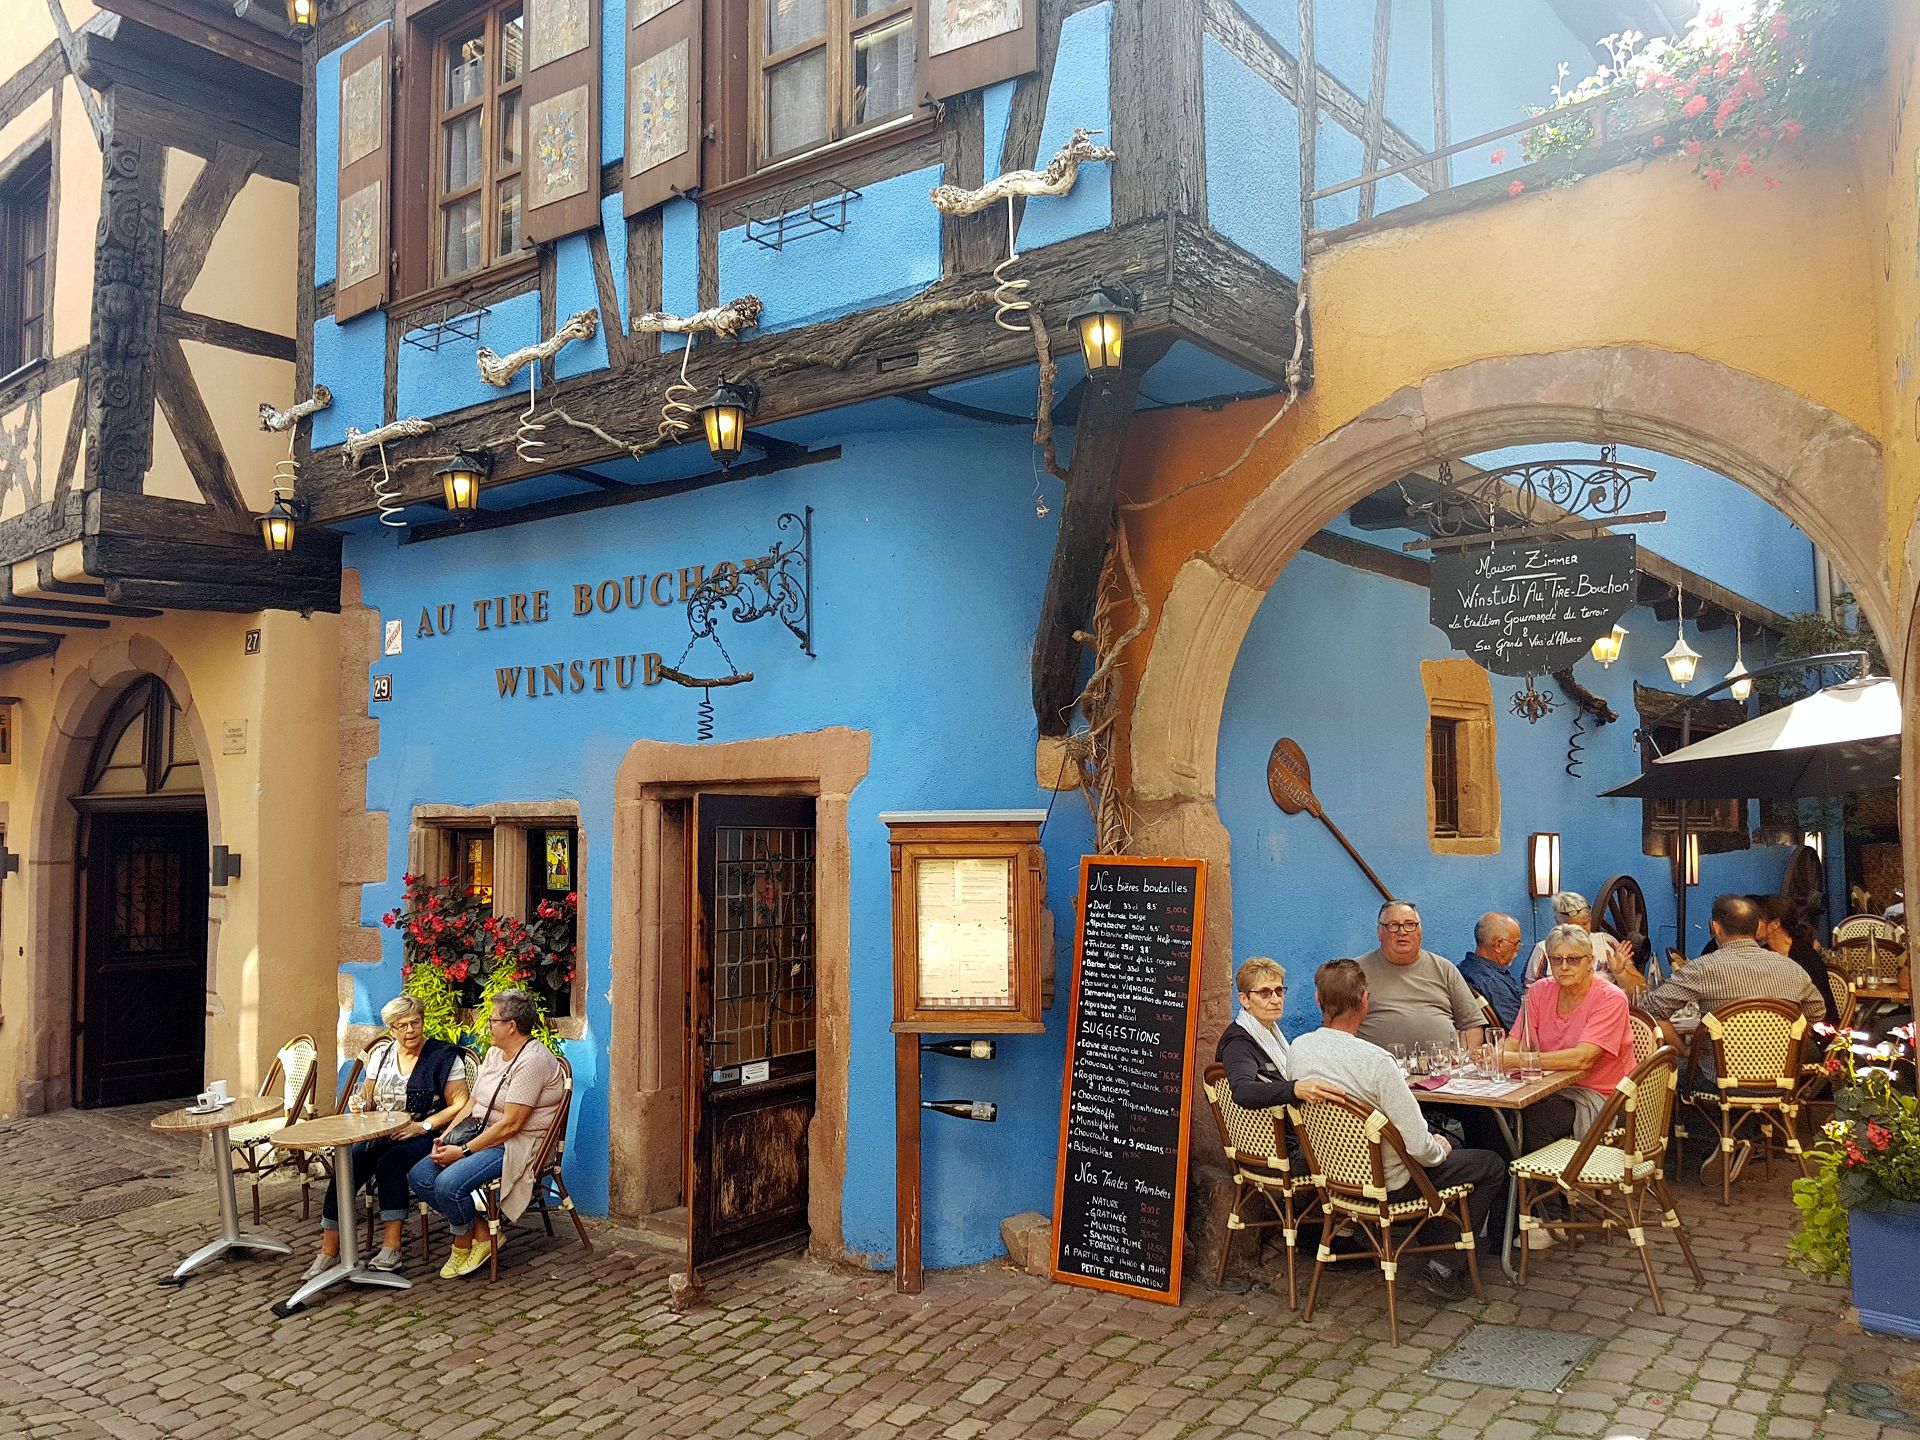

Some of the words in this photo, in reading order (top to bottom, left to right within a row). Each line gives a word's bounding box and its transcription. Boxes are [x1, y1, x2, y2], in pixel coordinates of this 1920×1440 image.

[1475, 556, 1517, 579] Maison
[416, 603, 455, 638] AU
[472, 589, 549, 631] TIRE
[572, 556, 771, 616] BOUCHON
[1448, 614, 1462, 629] La
[1463, 612, 1500, 628] tradition
[1503, 608, 1557, 635] Gourmande
[1564, 606, 1577, 619] du
[1580, 605, 1609, 619] terroir
[246, 633, 259, 651] 27
[1473, 639, 1491, 652] Ses
[1495, 638, 1523, 657] Grands
[1528, 633, 1544, 648] Vins
[1546, 630, 1582, 647] d'Alsace
[495, 652, 663, 699] WINSTUB
[374, 679, 389, 698] 29
[1090, 870, 1113, 892] Nos
[1116, 876, 1140, 892] bières
[1142, 878, 1188, 893] bouteilles
[1092, 900, 1112, 910] Duvel
[1107, 912, 1127, 920] blonde
[1128, 912, 1147, 922] belge
[1155, 958, 1177, 968] rouges
[1111, 982, 1119, 990] du
[1117, 1012, 1137, 1021] alcool
[1100, 1042, 1109, 1051] de
[1130, 1047, 1139, 1055] de
[1079, 1057, 1115, 1071] Choucroute
[1131, 1057, 1145, 1065] miel
[1078, 1069, 1104, 1084] Rognon
[1077, 1089, 1116, 1105] Choucroute
[1098, 1082, 1132, 1096] l'ancienne
[1074, 1127, 1110, 1141] Choucroute
[1128, 1138, 1135, 1148] 3
[1135, 1141, 1164, 1155] poissons
[1074, 1161, 1098, 1184] Nos
[1091, 1195, 1120, 1209] NATURE
[1091, 1220, 1128, 1236] MUNSTER
[1089, 1230, 1119, 1244] SAUMON
[1073, 1247, 1100, 1262] PARTIR
[1103, 1255, 1115, 1265] DE
